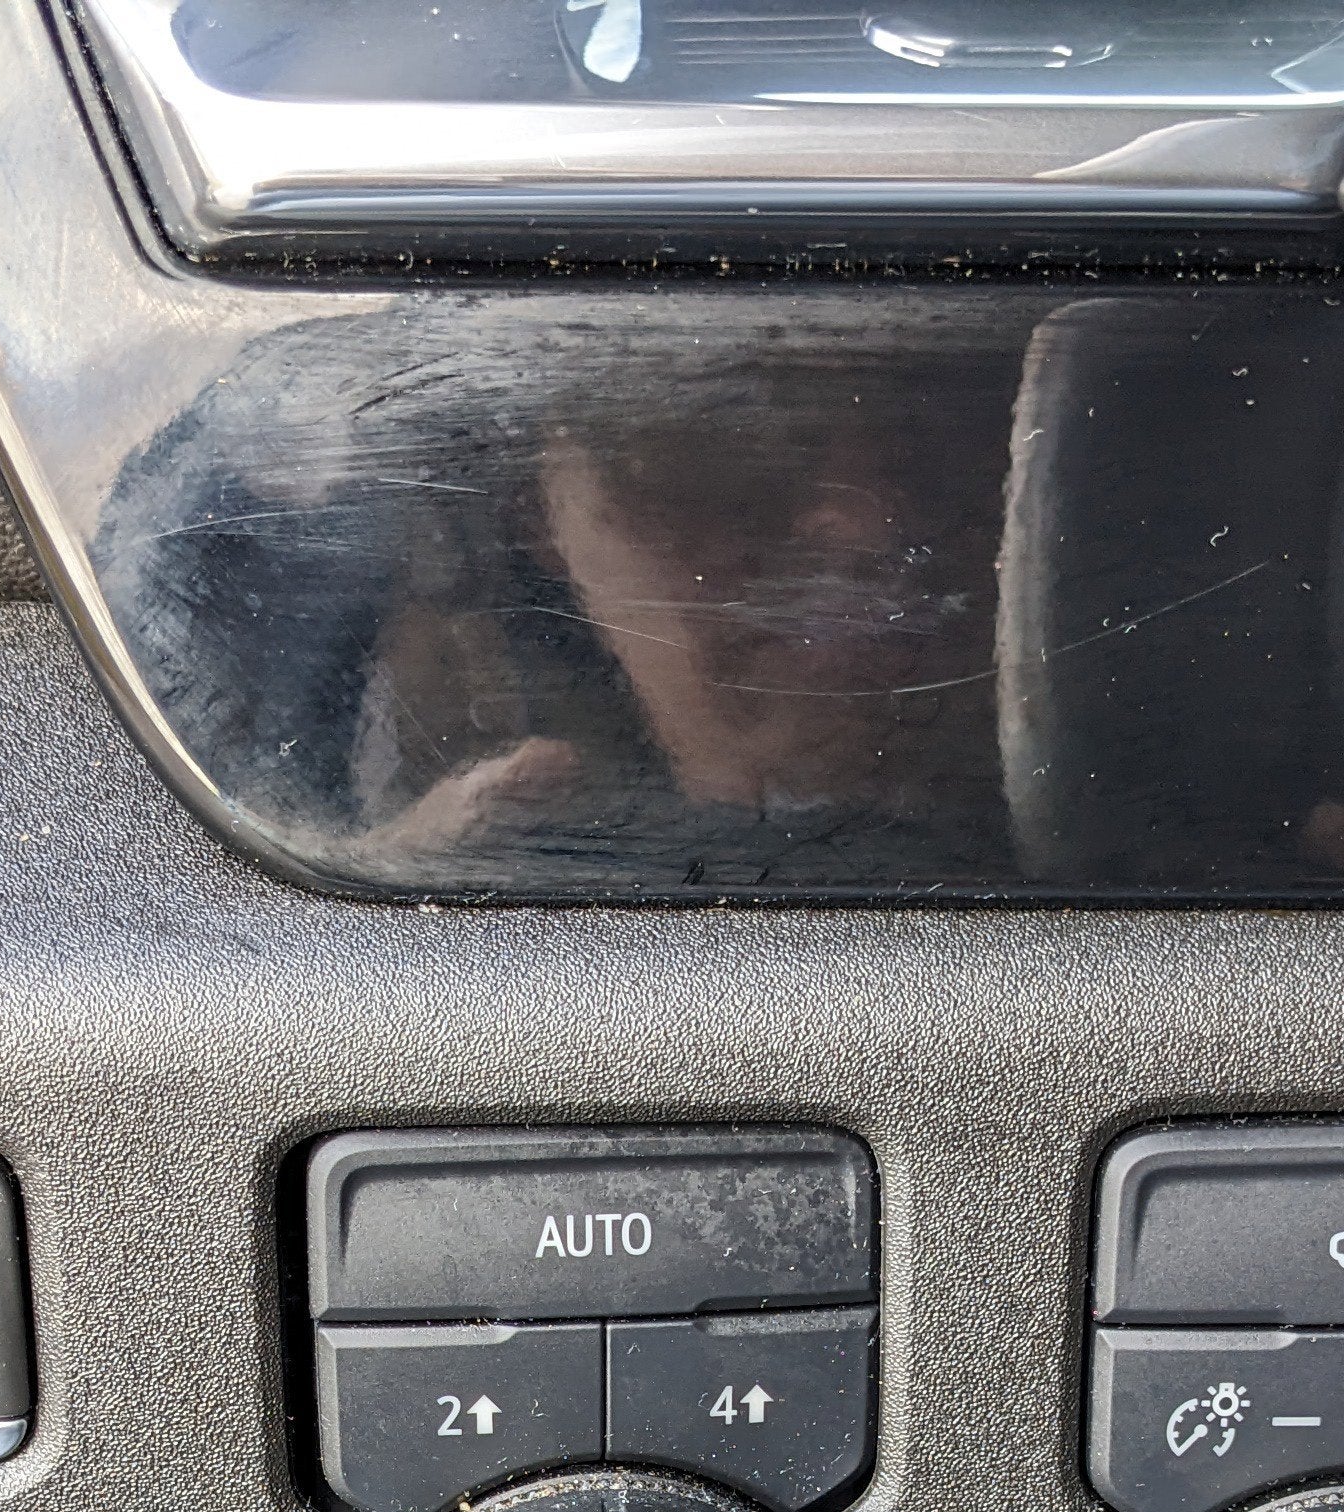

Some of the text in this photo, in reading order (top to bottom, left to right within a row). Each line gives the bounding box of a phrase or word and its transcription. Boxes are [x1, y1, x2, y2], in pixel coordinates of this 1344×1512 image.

[534, 1212, 652, 1258] AUTO
[436, 1395, 463, 1436] 2
[709, 1385, 738, 1425] 4
